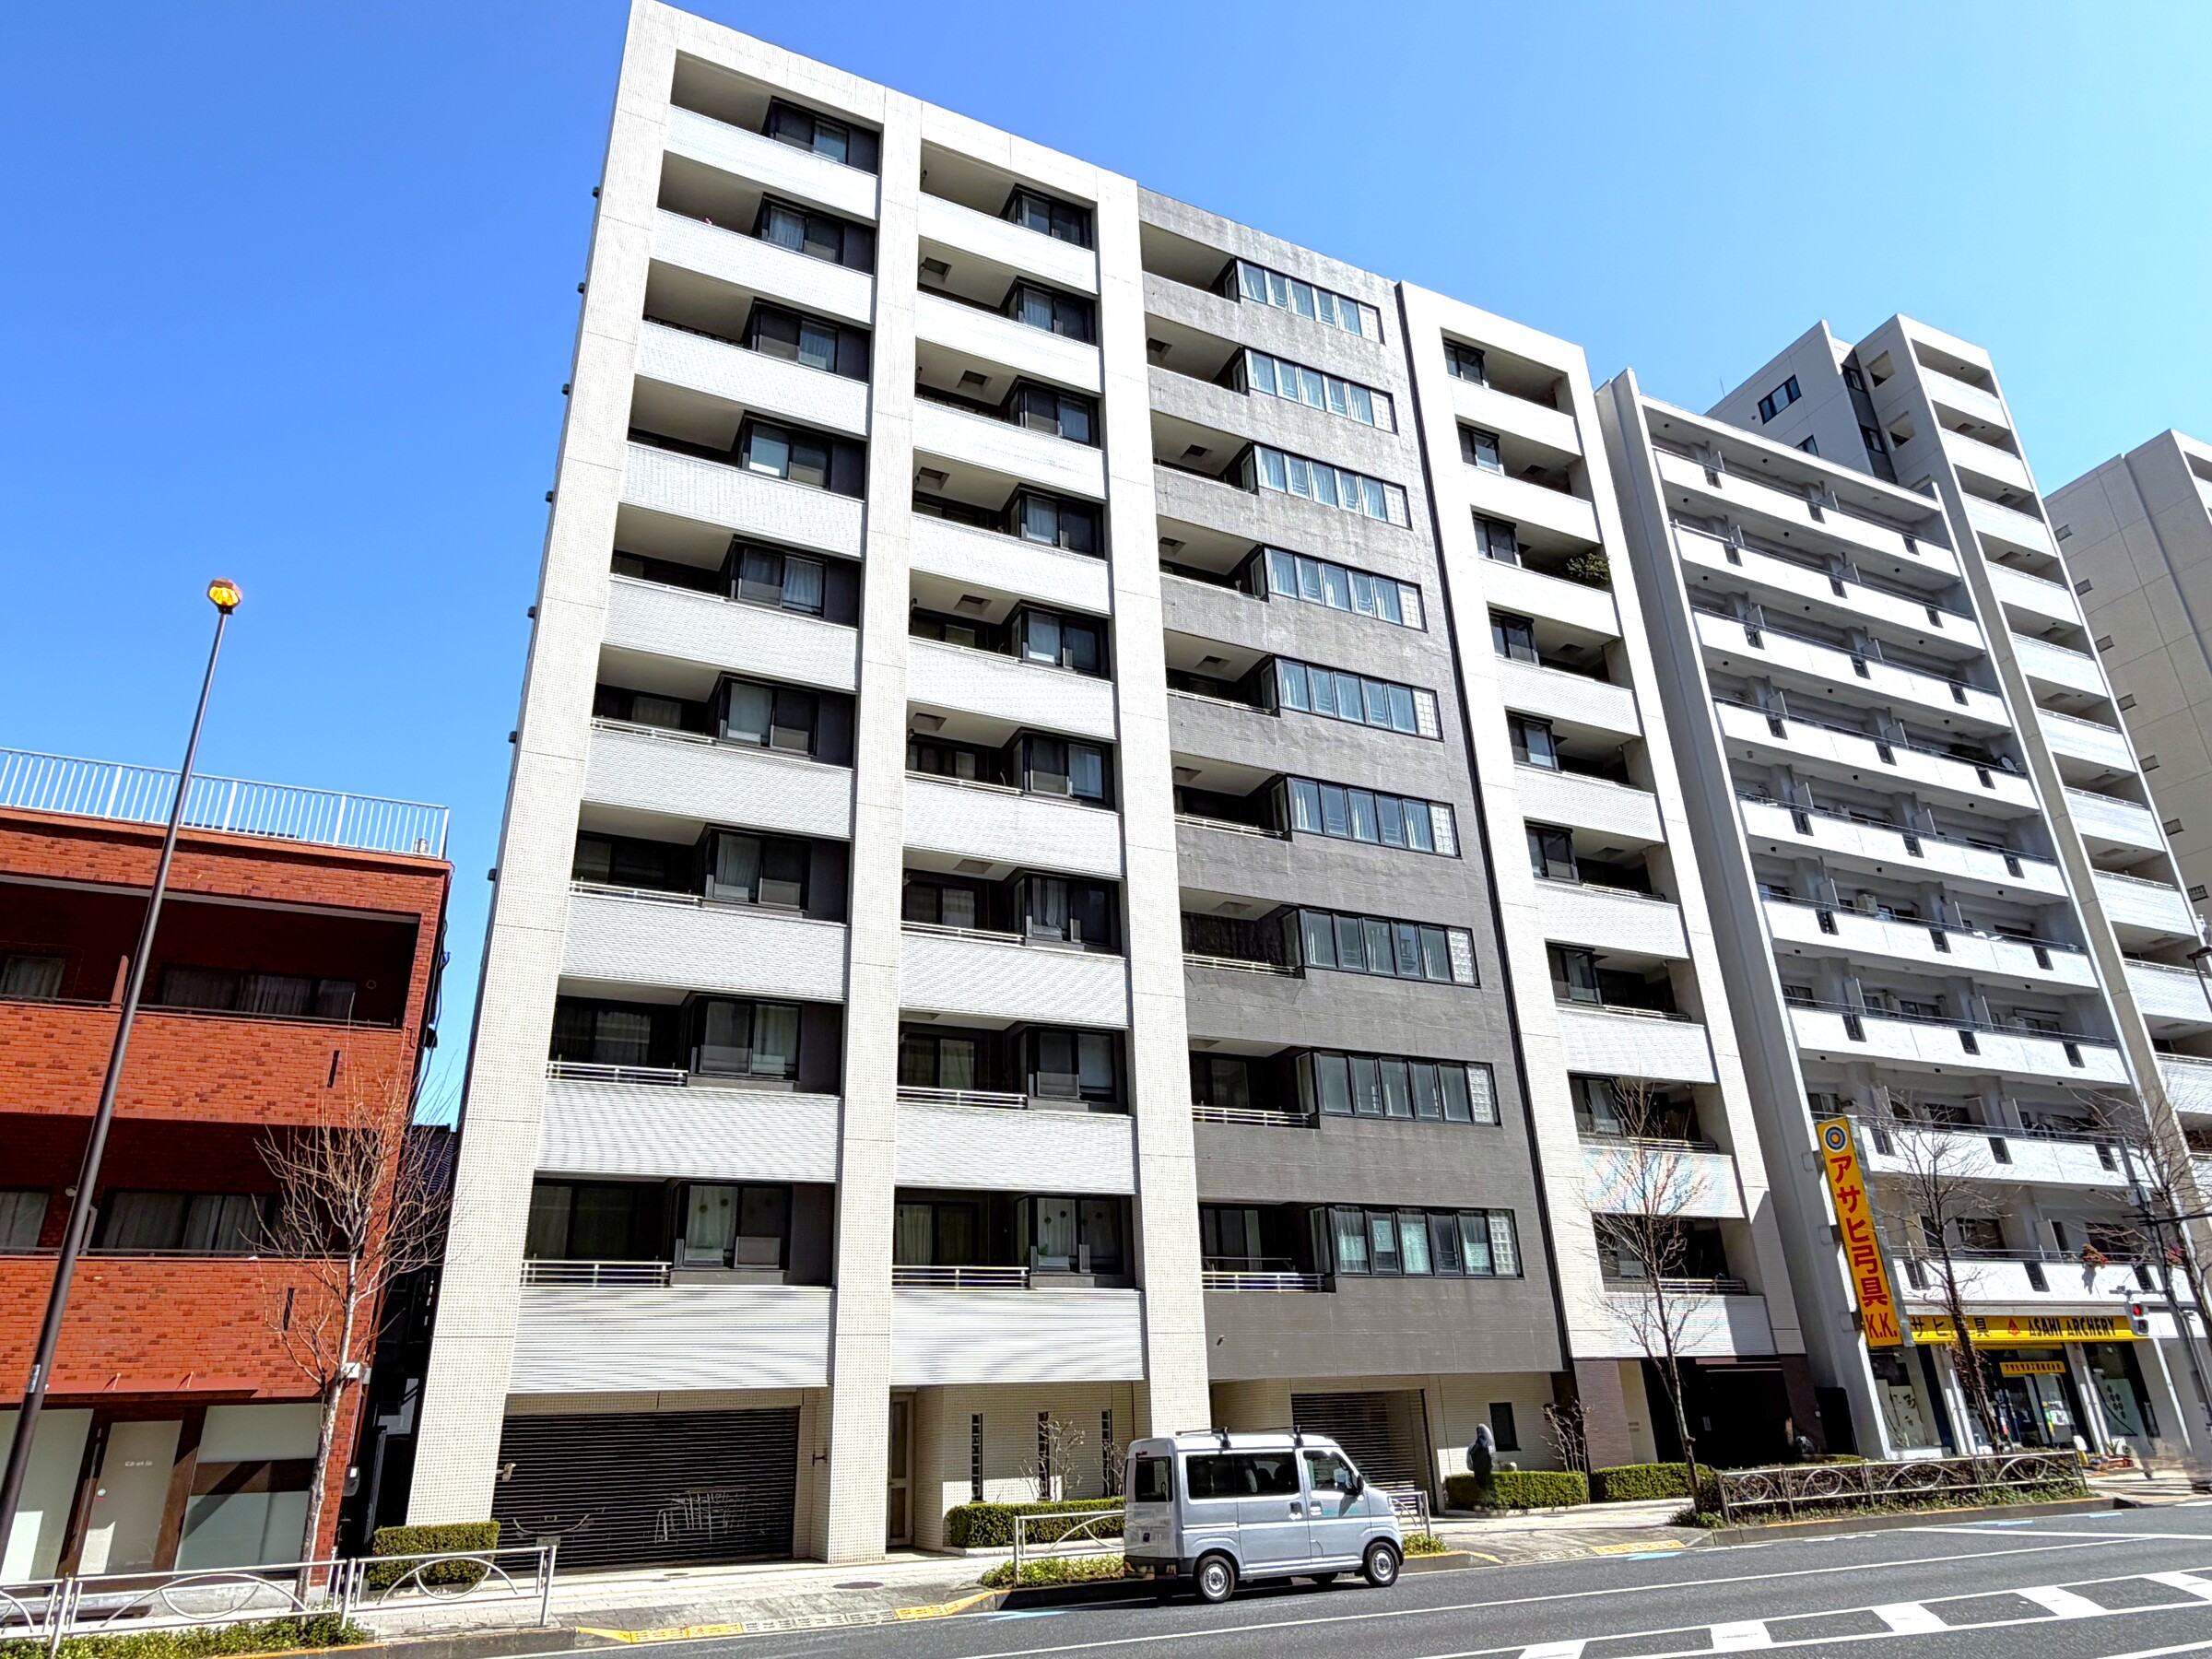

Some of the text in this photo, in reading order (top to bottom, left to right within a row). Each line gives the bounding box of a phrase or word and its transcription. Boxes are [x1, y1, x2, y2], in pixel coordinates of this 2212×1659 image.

[1830, 1155, 1898, 1339] アサヒ弓具 K.K.
[1911, 1316, 1990, 1337] サヒ具
[2028, 1315, 2116, 1336] ASAHI ARCHERY
